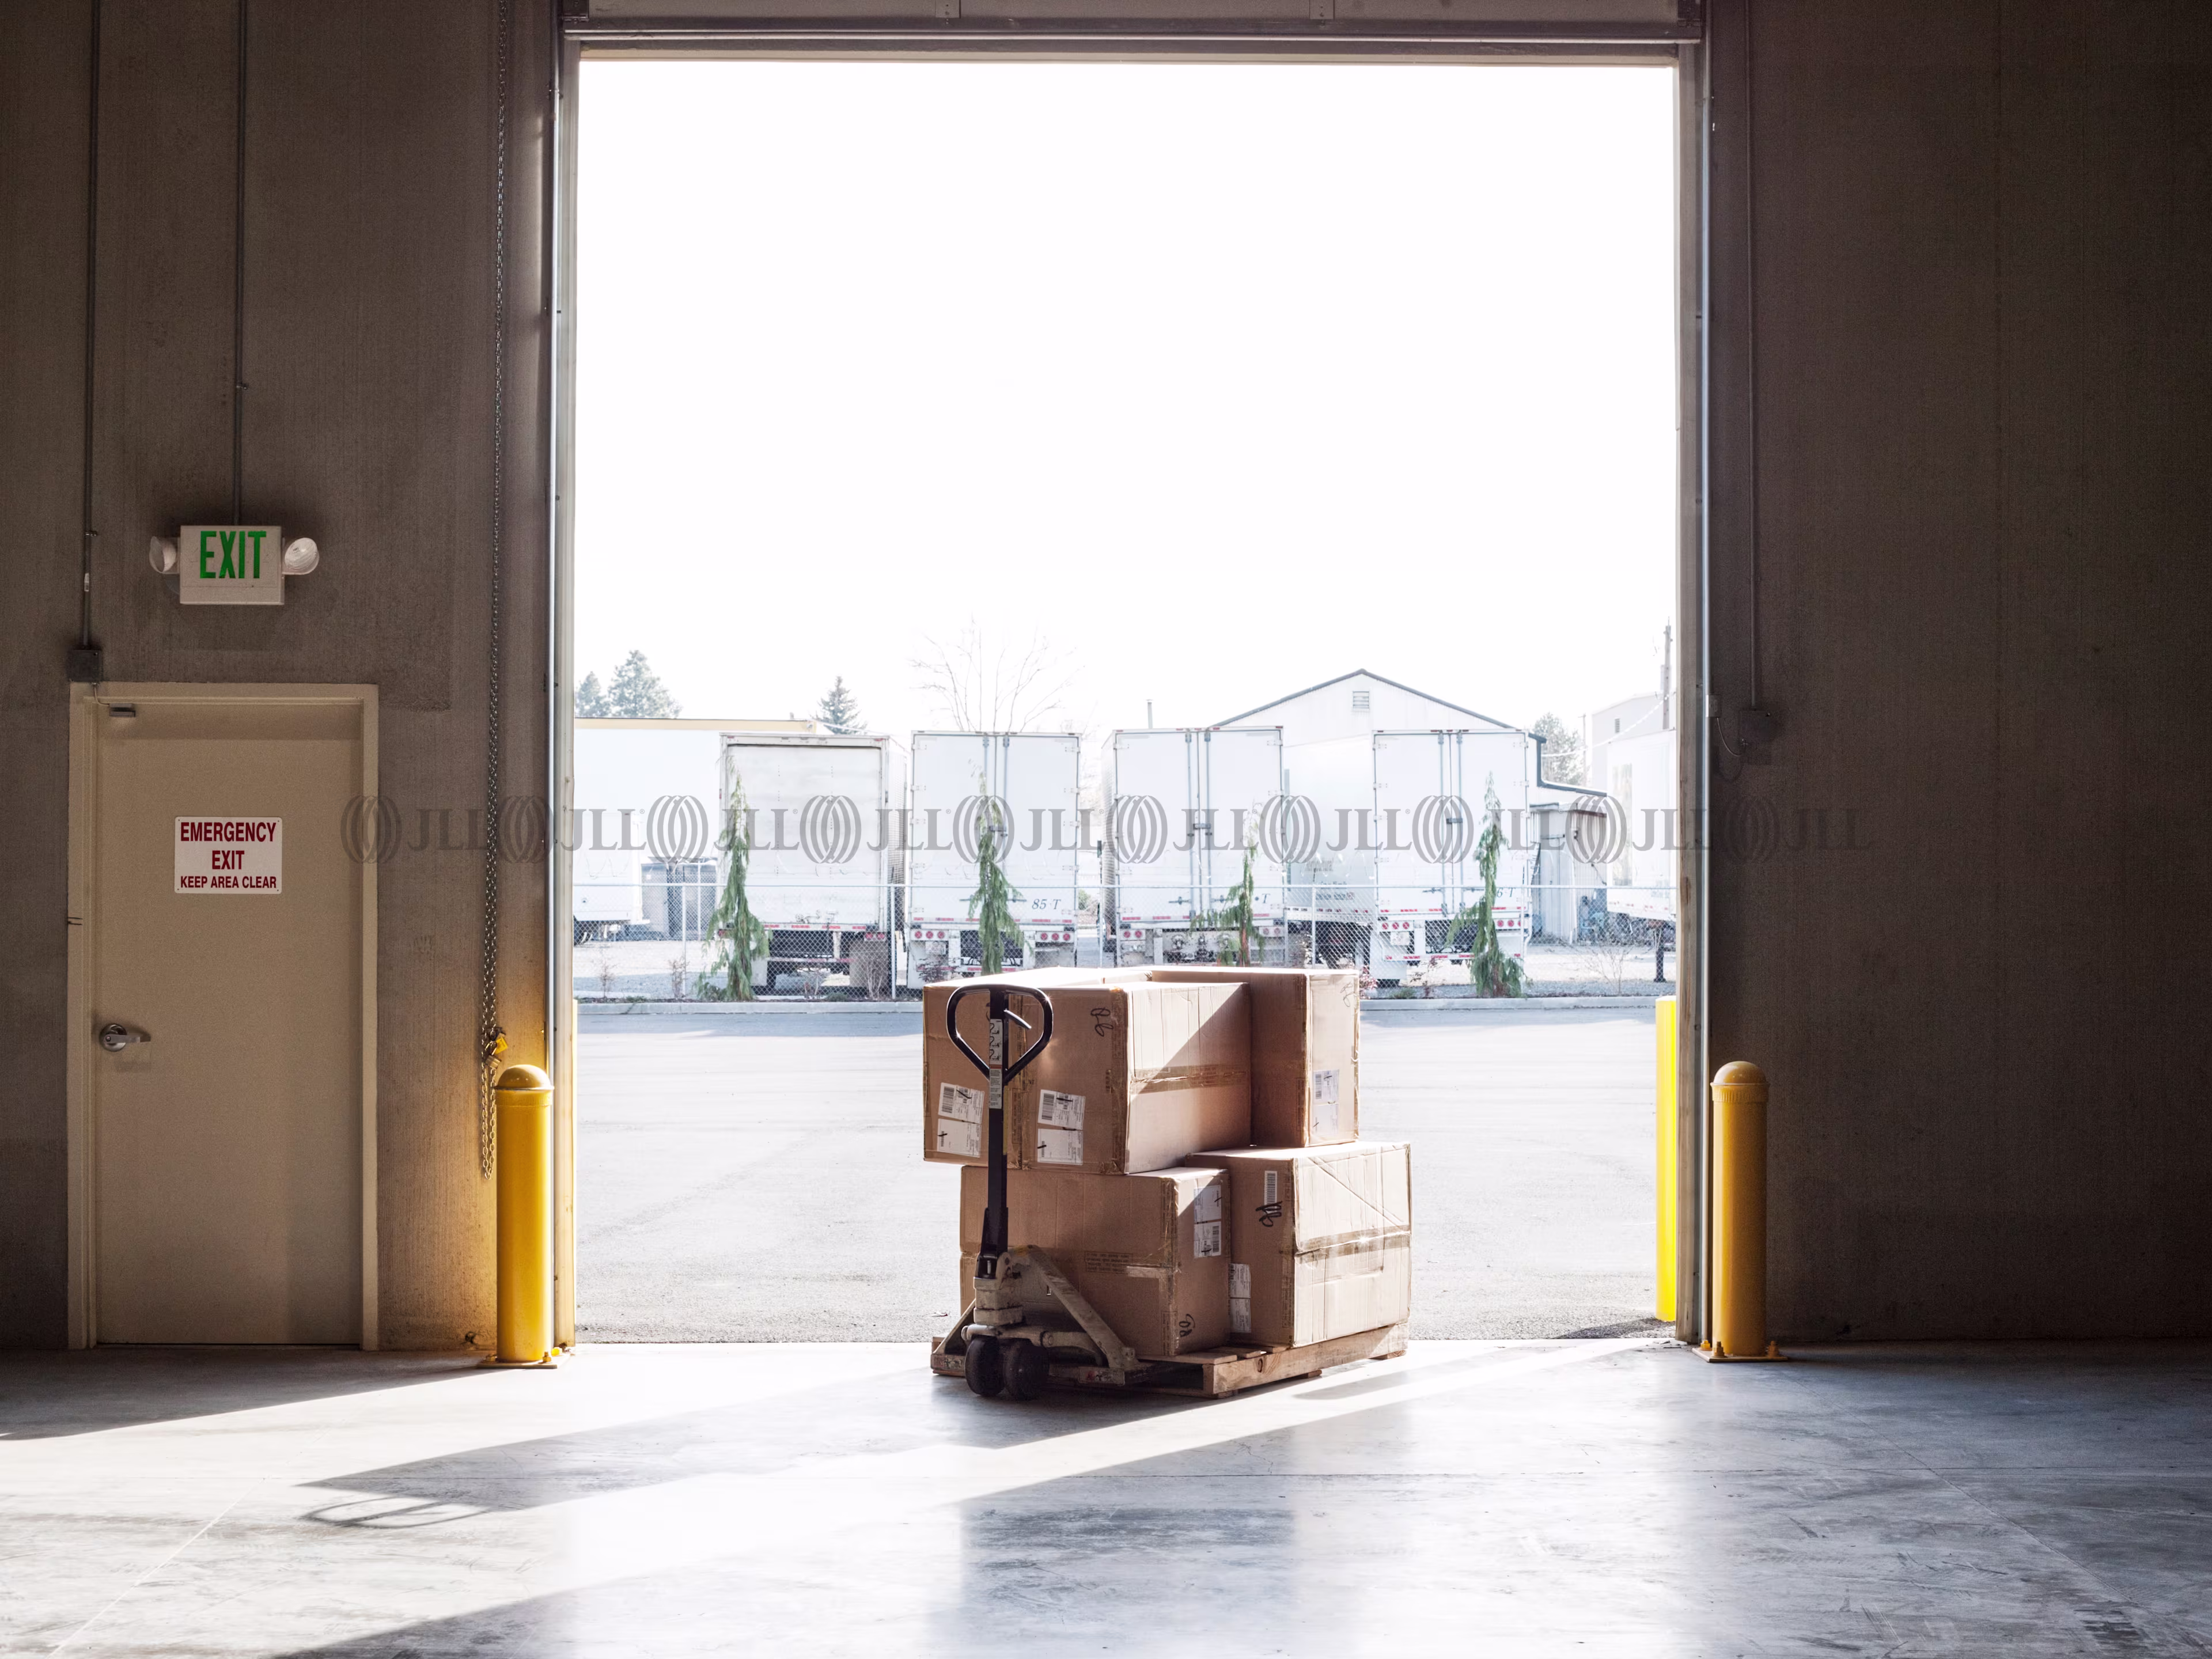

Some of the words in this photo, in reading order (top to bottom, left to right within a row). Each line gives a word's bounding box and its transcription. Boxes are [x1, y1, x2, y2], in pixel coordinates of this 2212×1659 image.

[200, 531, 267, 579] EXIT
[180, 821, 276, 843] EMERGENCY
[211, 850, 245, 870] EXIT
[180, 876, 208, 889] KEEP
[211, 876, 239, 889] AREA
[241, 876, 276, 889] CLEAR
[1032, 899, 1047, 910] 85
